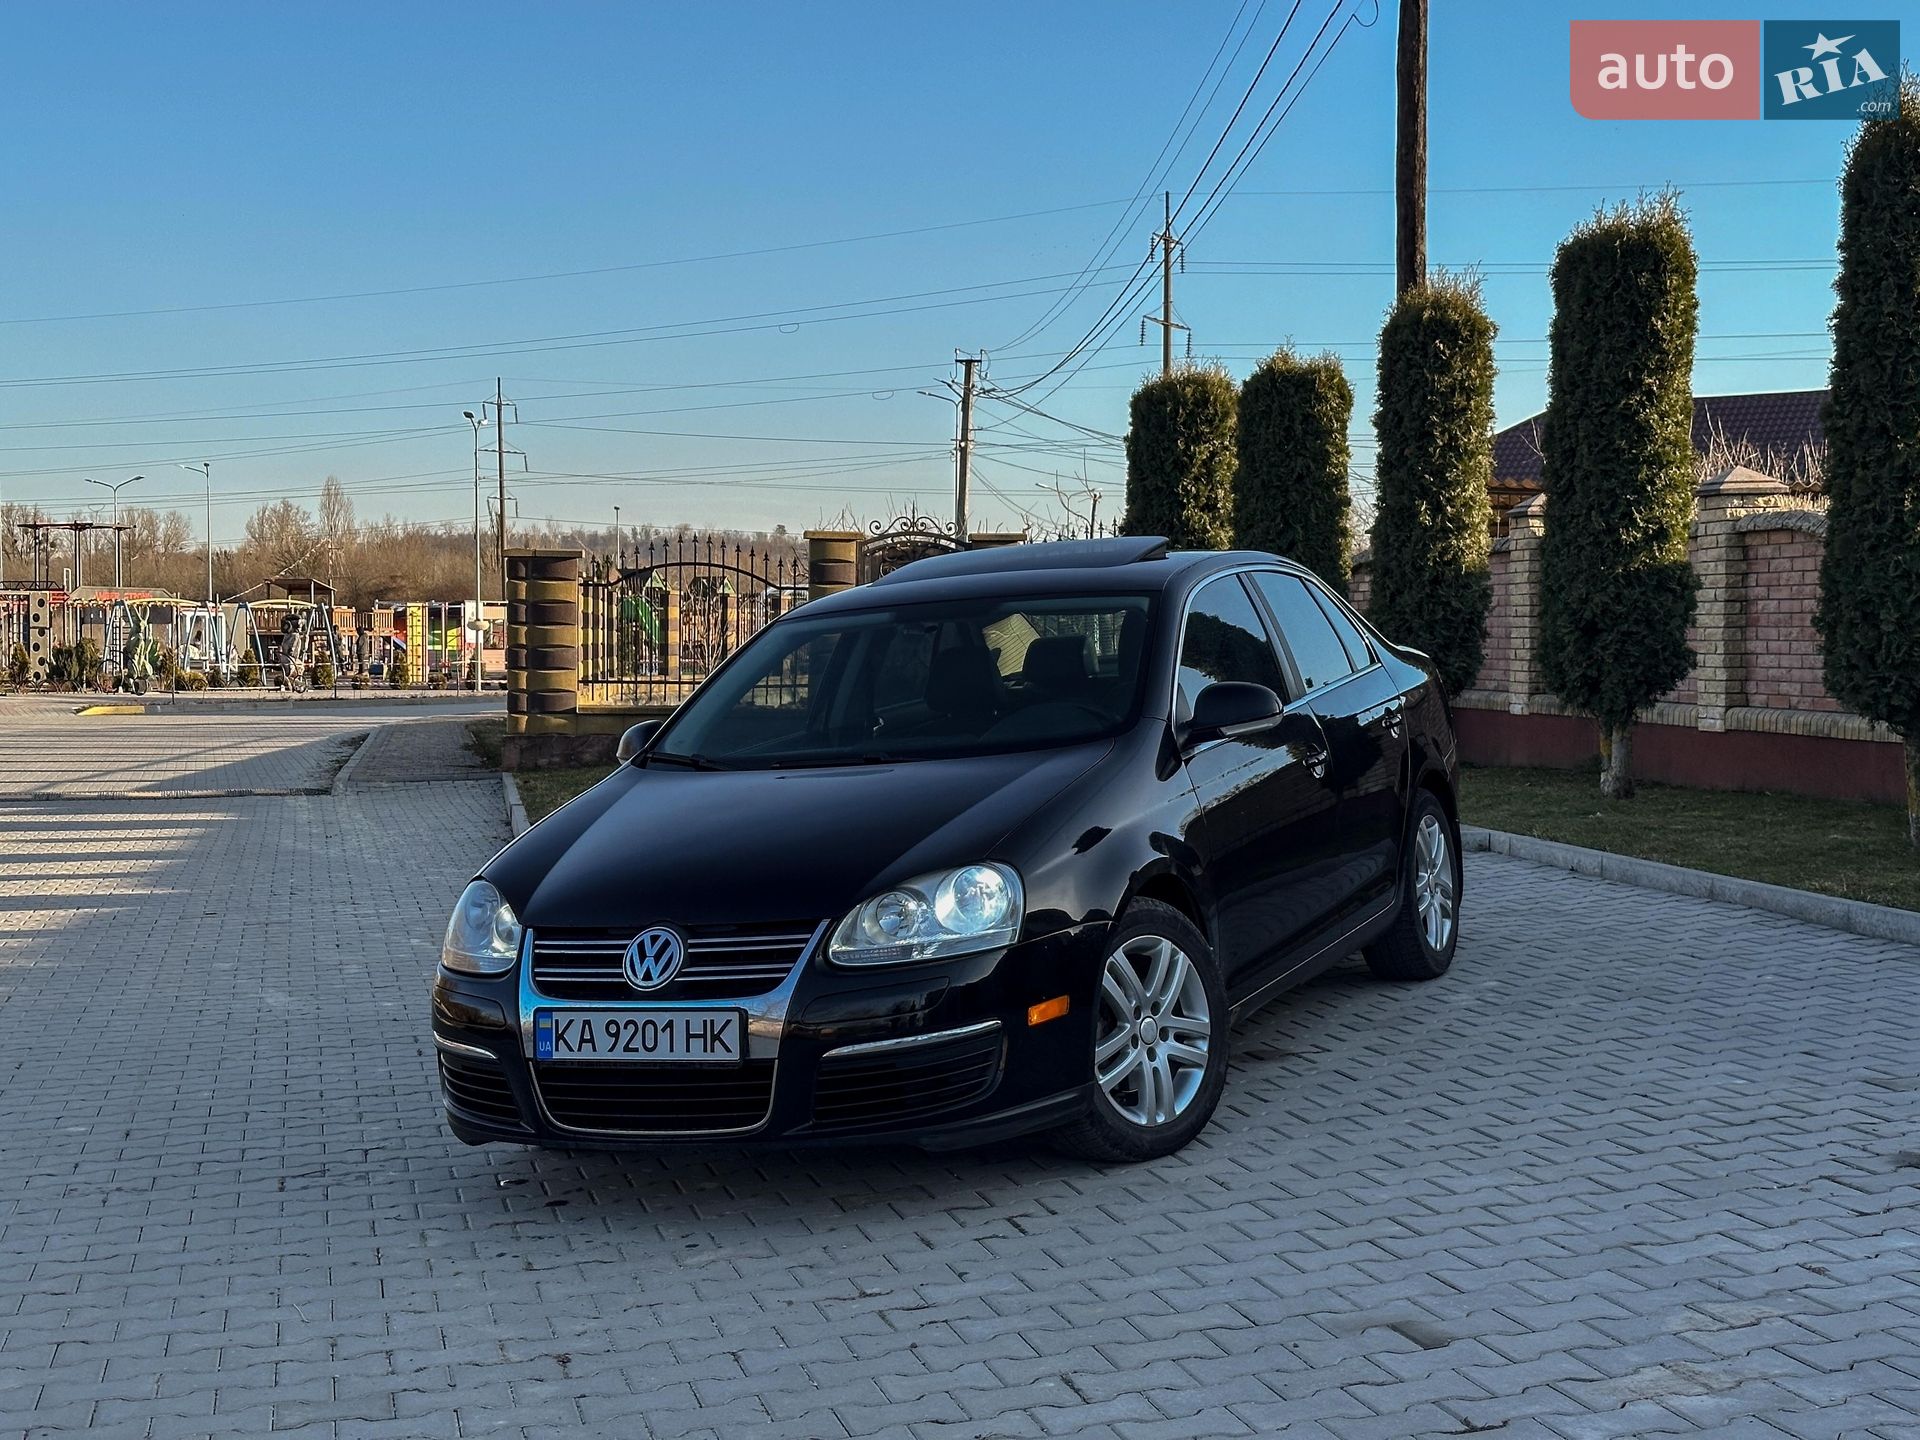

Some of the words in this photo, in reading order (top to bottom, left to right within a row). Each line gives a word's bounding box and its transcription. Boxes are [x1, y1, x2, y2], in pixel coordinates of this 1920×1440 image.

[539, 1041, 551, 1052] UA
[554, 1018, 597, 1053] KA
[604, 1018, 675, 1053] 9201
[685, 1018, 733, 1053] HK
